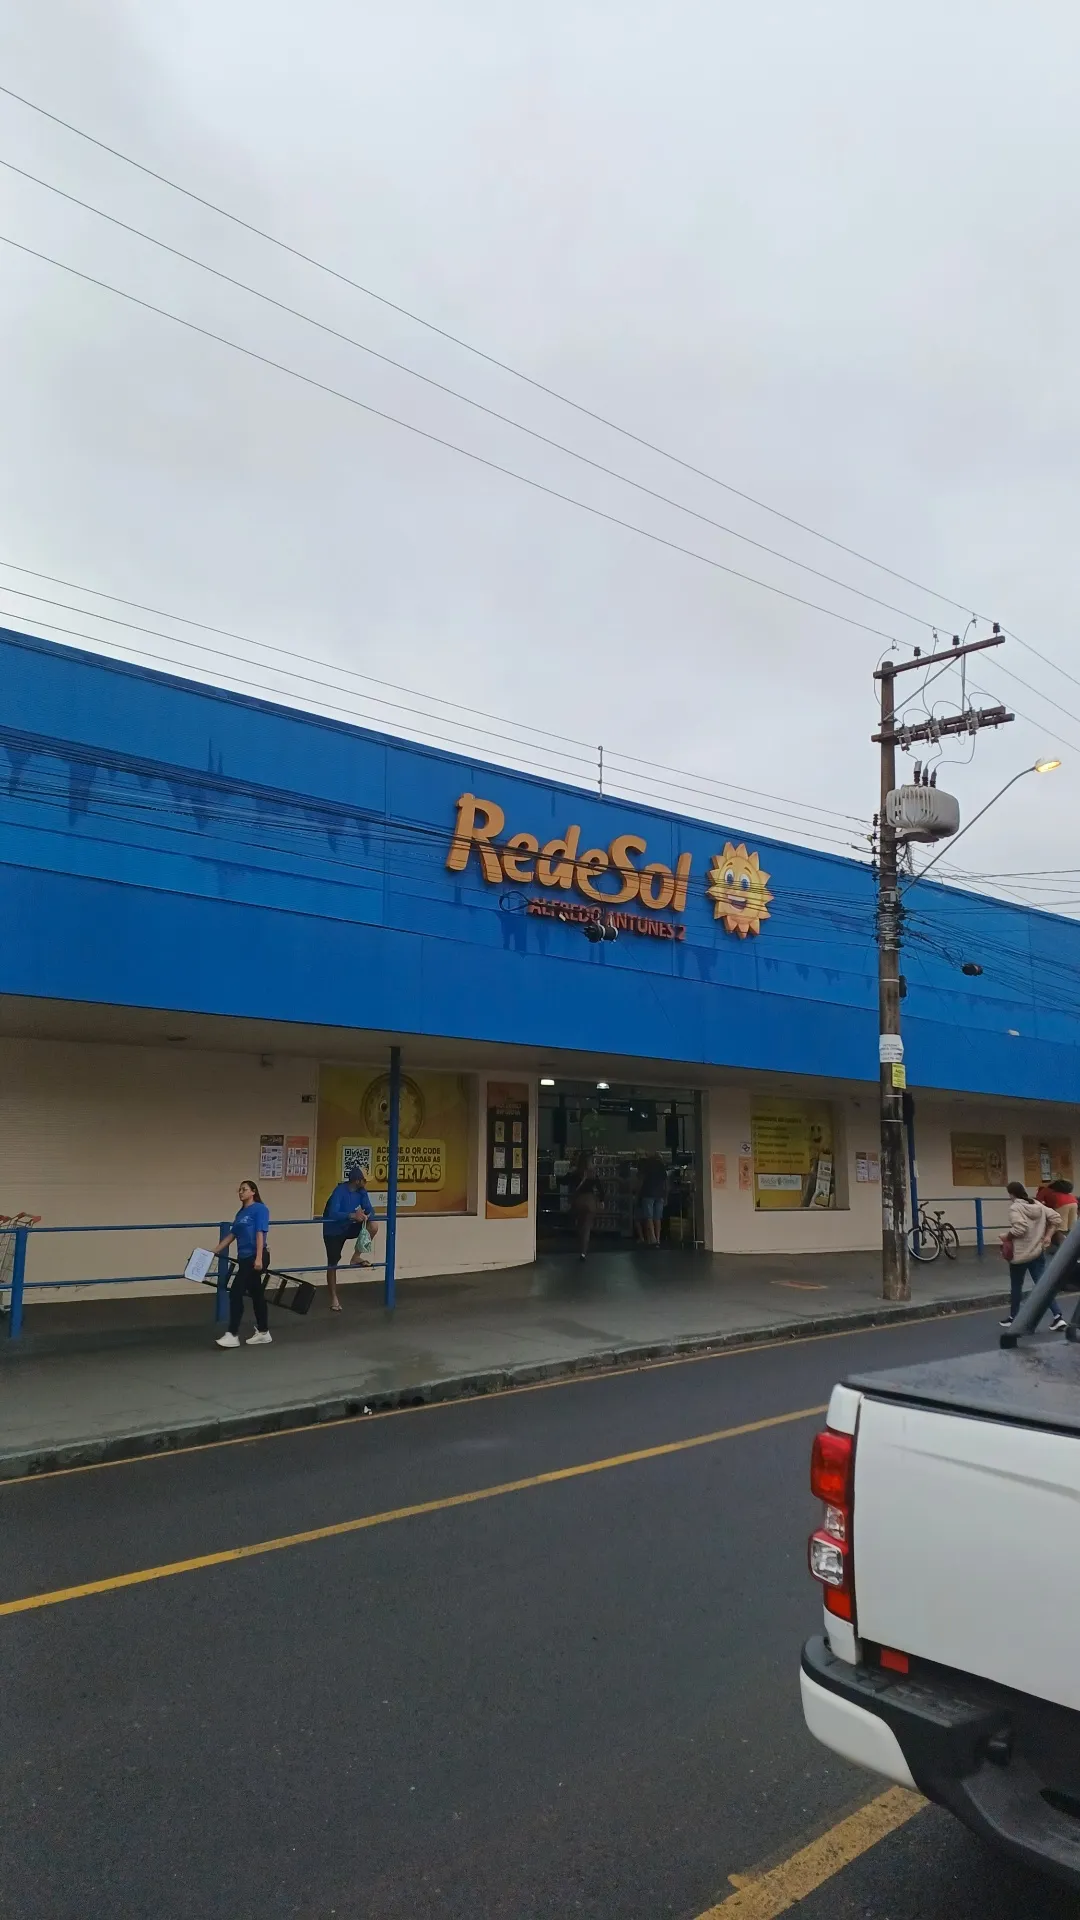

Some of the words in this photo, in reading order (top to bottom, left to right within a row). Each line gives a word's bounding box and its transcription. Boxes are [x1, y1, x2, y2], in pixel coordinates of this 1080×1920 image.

[446, 792, 692, 913] RedeSol
[606, 911, 675, 939] ANTUNES
[677, 926, 687, 941] 2
[375, 1164, 441, 1182] OERTAS
